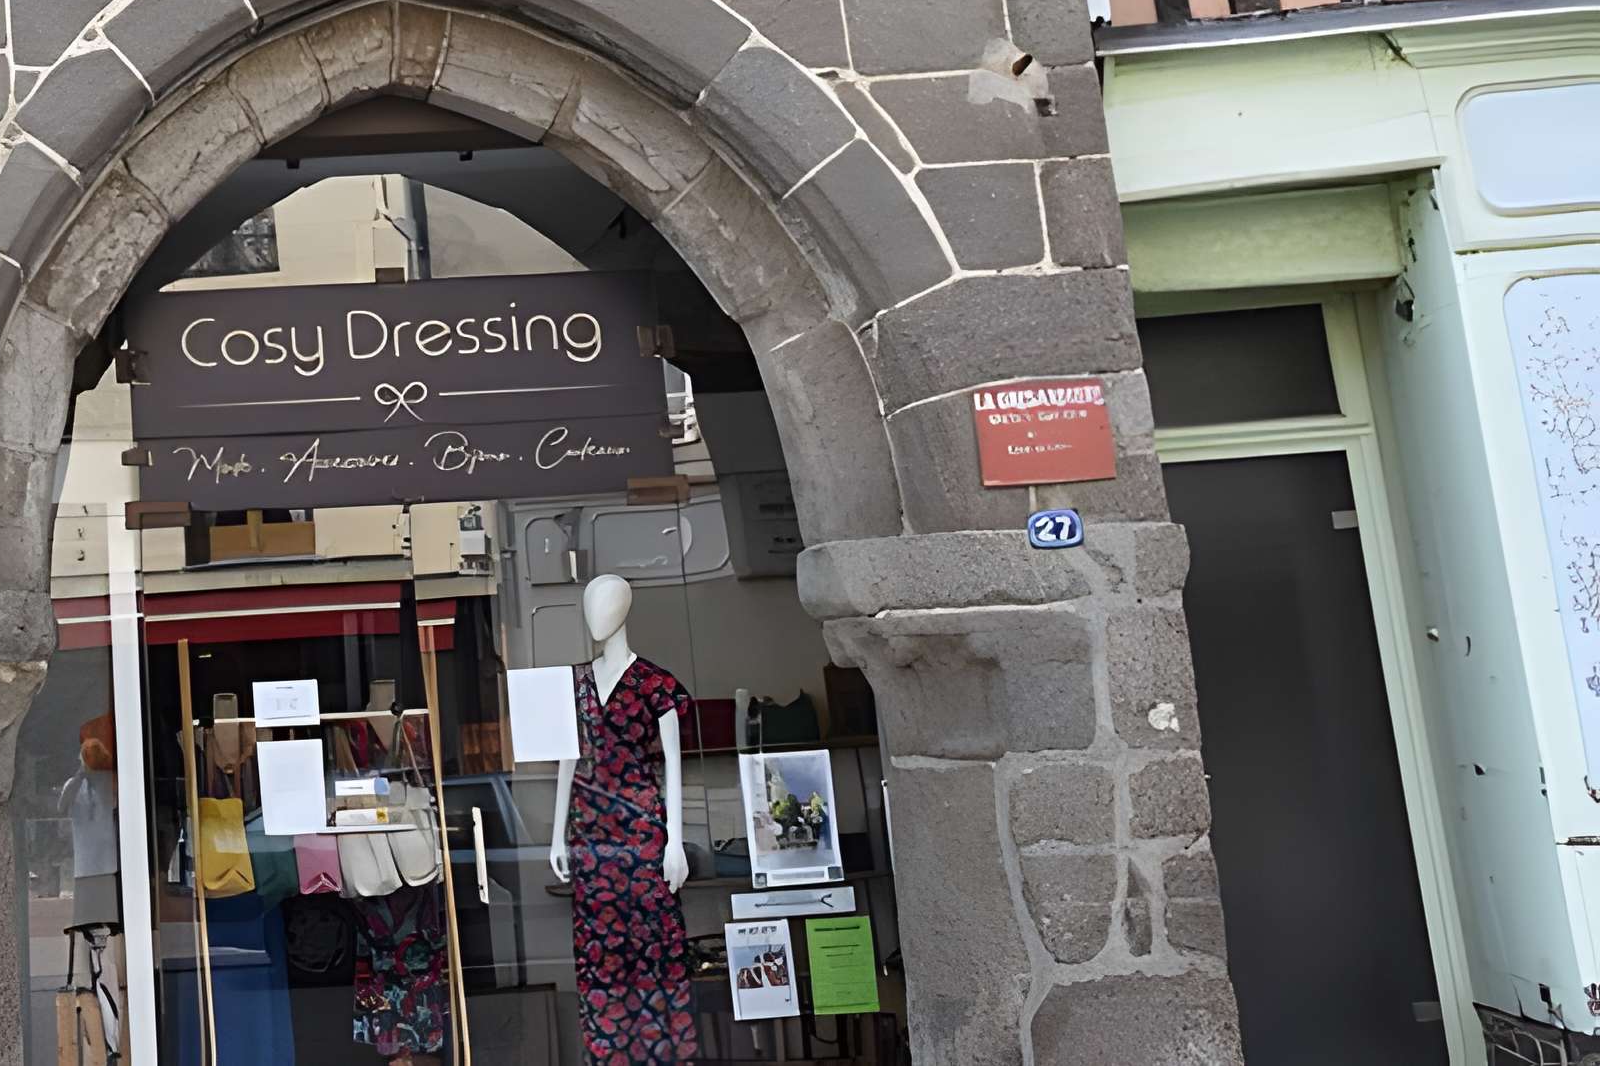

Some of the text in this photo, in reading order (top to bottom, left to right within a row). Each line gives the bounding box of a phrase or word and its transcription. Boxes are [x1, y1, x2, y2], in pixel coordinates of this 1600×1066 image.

[181, 301, 602, 376] Cosy Dressing
[1034, 515, 1072, 542] 27
